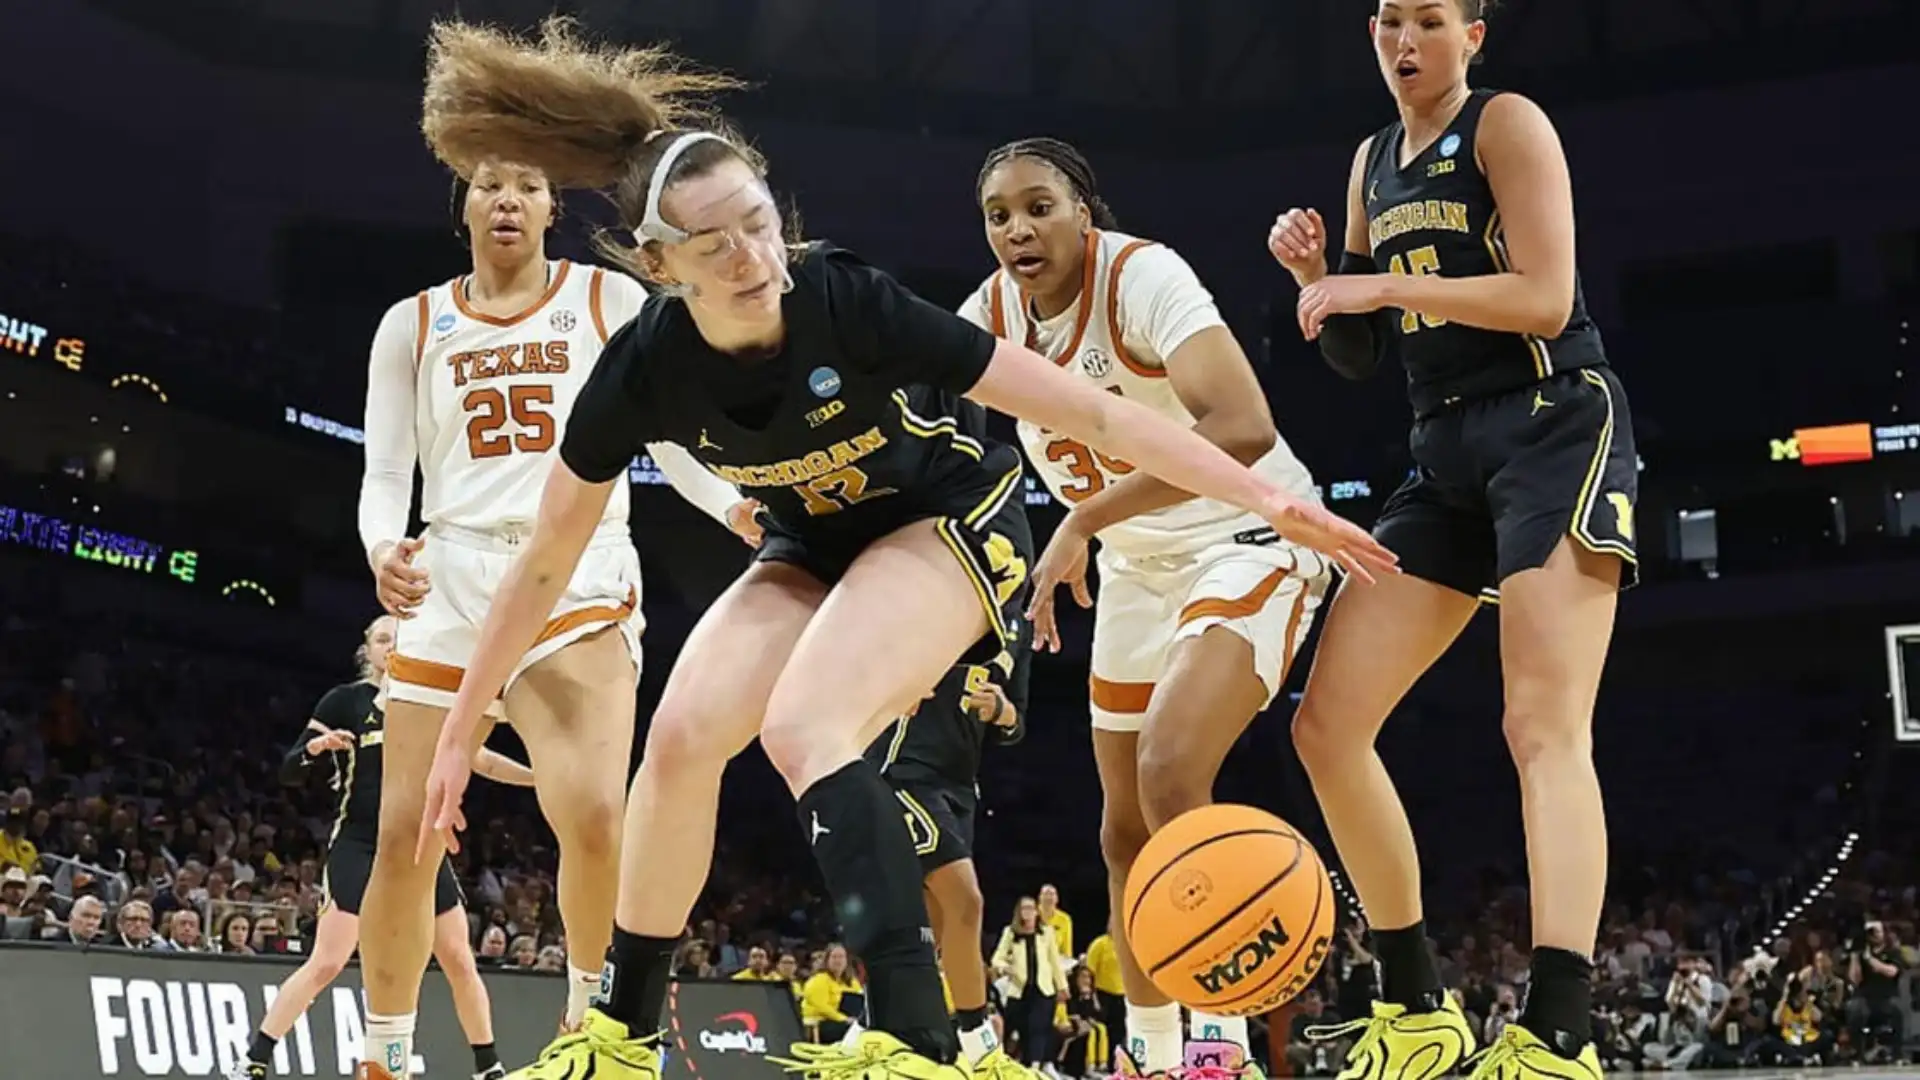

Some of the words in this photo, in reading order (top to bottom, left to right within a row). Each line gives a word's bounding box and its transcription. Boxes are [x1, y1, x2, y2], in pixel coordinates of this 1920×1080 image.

[448, 340, 570, 386] TEXAS
[462, 385, 556, 459] 25
[793, 466, 898, 516] 12
[1193, 915, 1291, 995] NCAA
[90, 976, 252, 1076] FOUR
